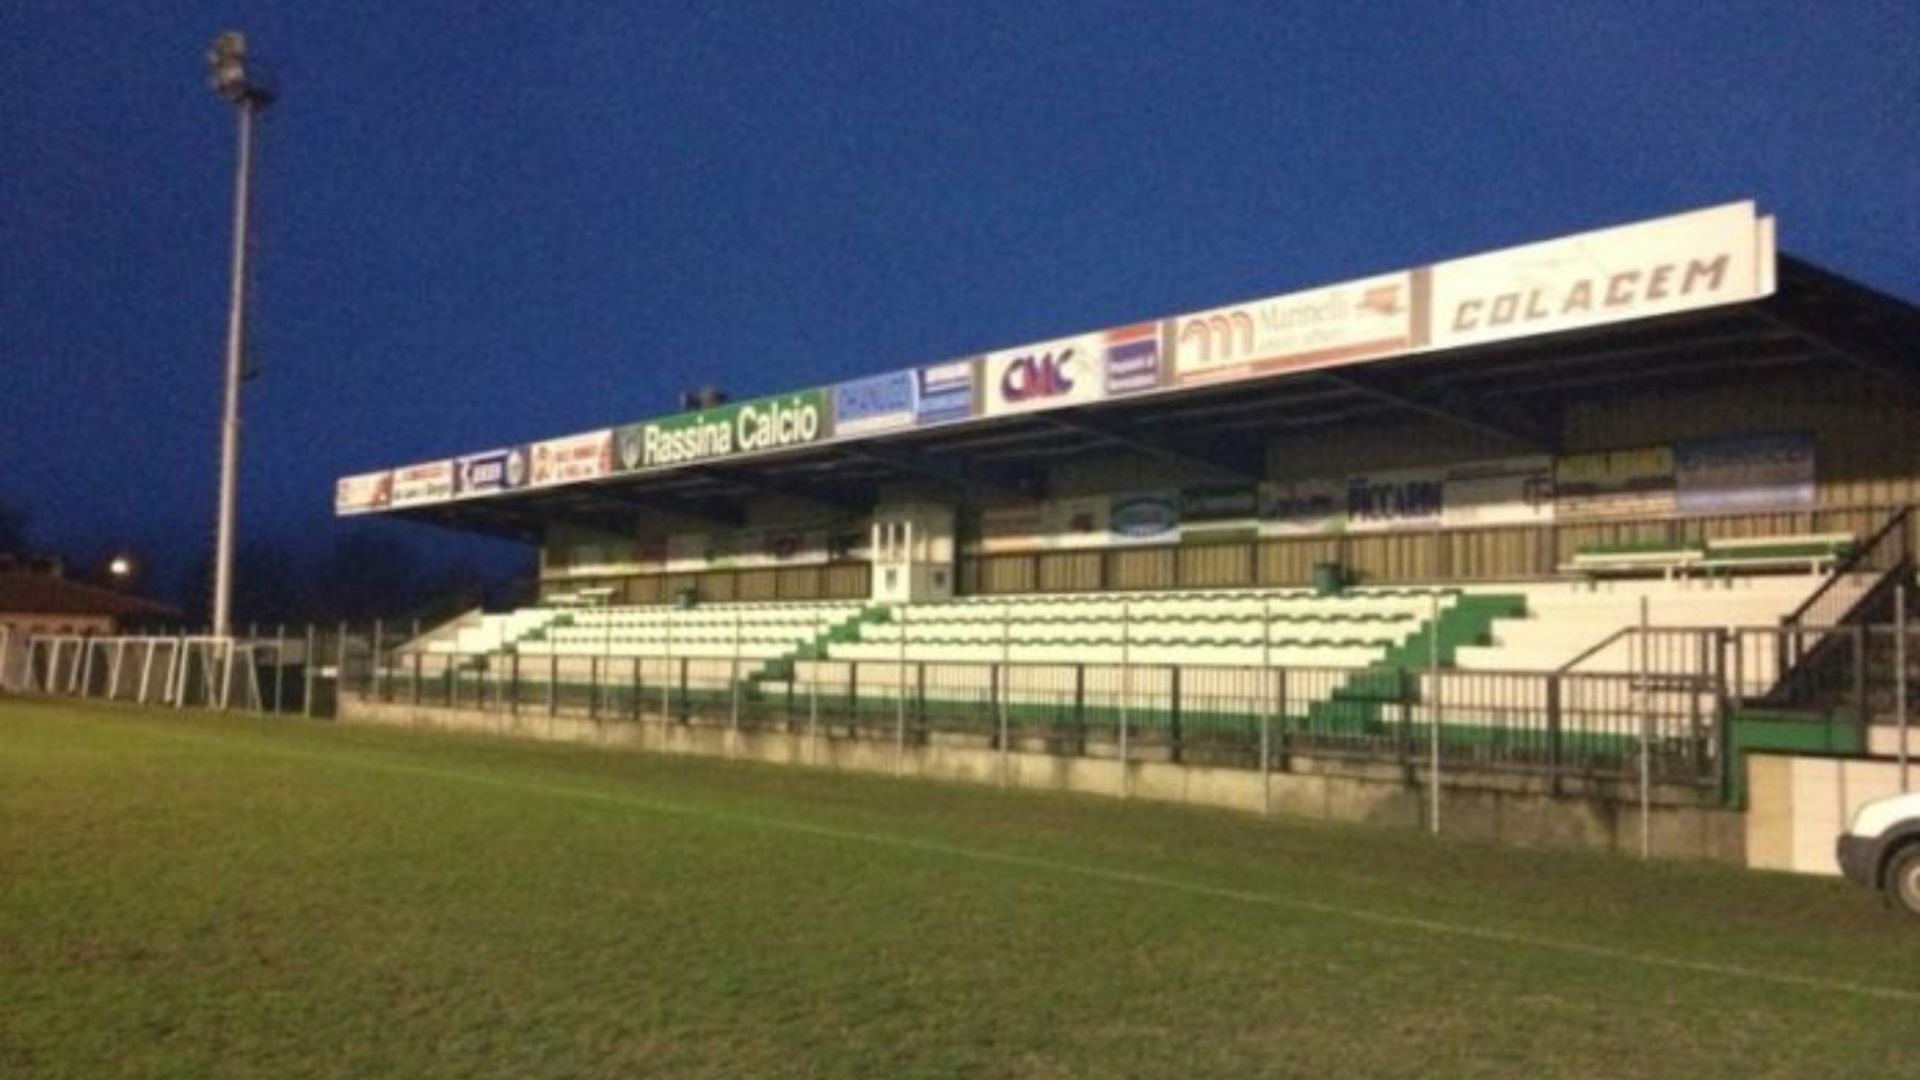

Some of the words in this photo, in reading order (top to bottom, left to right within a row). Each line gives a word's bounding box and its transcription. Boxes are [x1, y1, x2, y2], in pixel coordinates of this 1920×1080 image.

[1451, 253, 1732, 333] COLACEM
[1000, 347, 1075, 402] CMC
[643, 417, 730, 466] Rassina
[737, 398, 818, 450] Calcio
